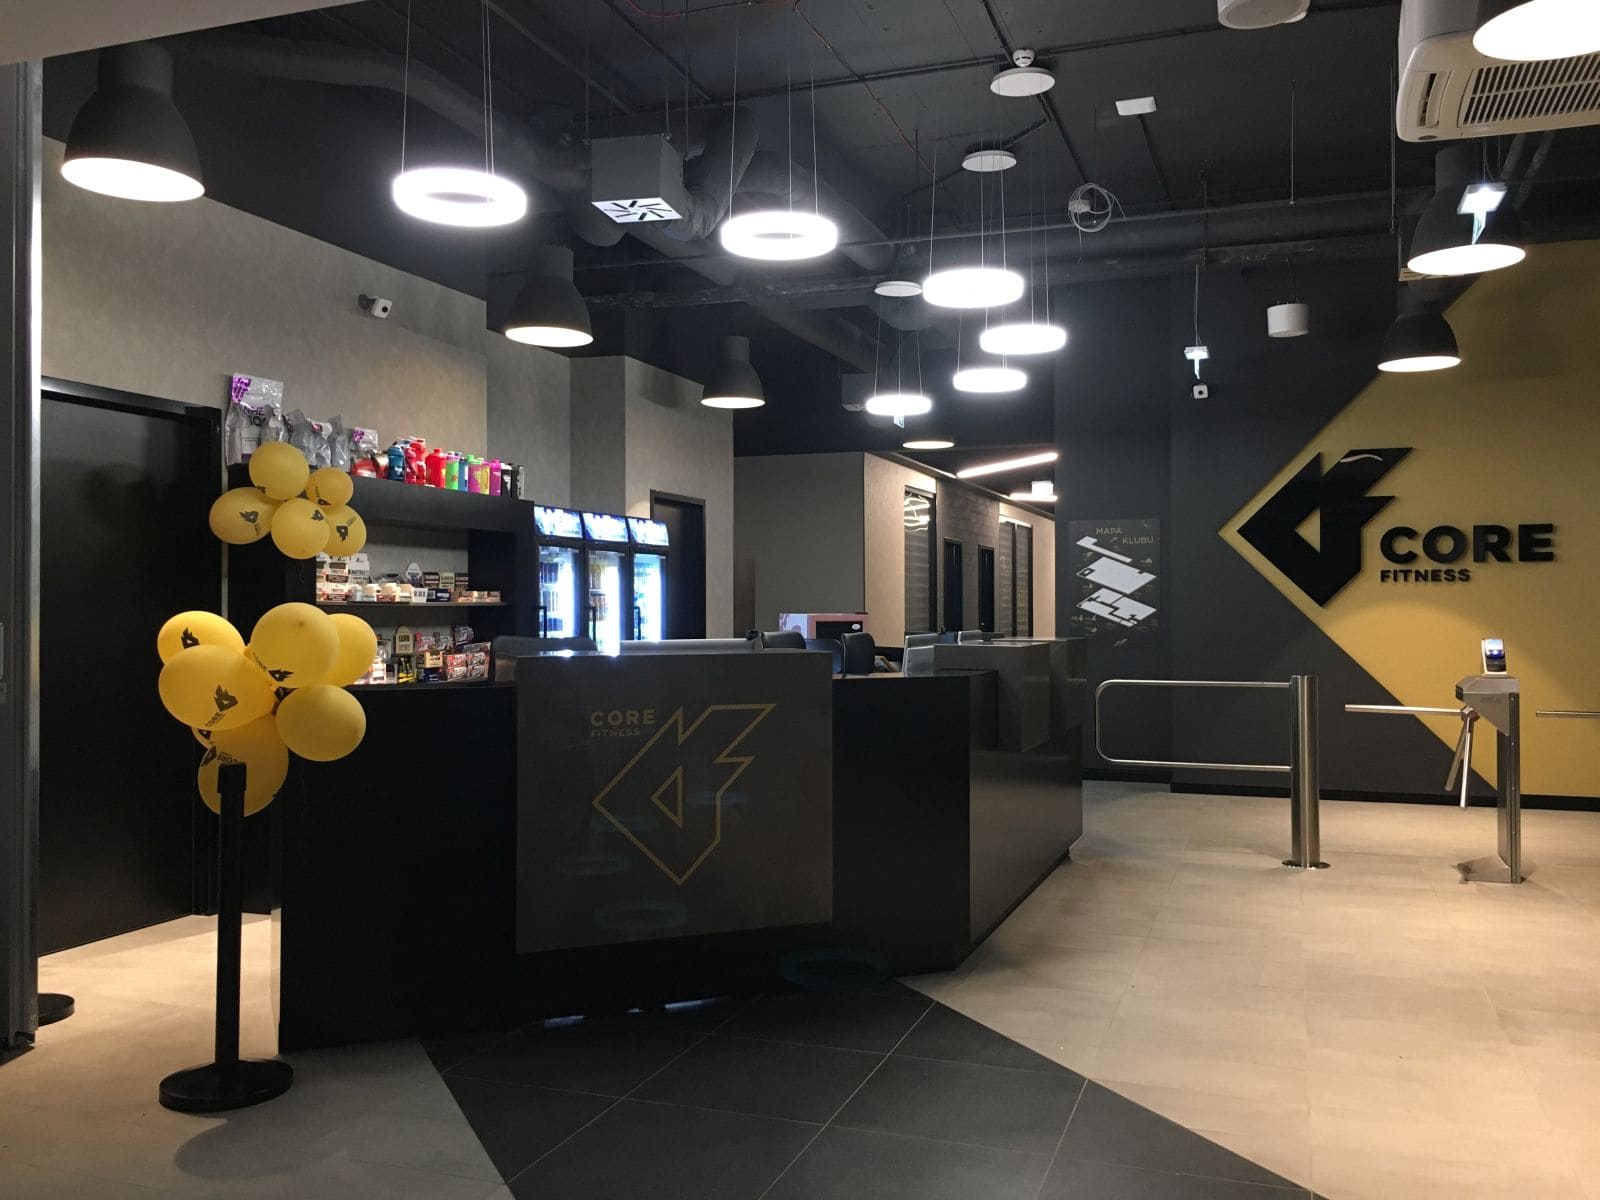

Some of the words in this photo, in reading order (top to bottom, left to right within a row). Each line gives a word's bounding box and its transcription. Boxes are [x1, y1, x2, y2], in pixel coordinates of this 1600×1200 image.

[1095, 527, 1122, 535] MAPA
[1122, 535, 1154, 545] KLUBU
[1380, 523, 1555, 564] CORE
[1380, 568, 1471, 583] FITNESS
[590, 709, 656, 727] CORE
[590, 727, 641, 738] FITNESS
